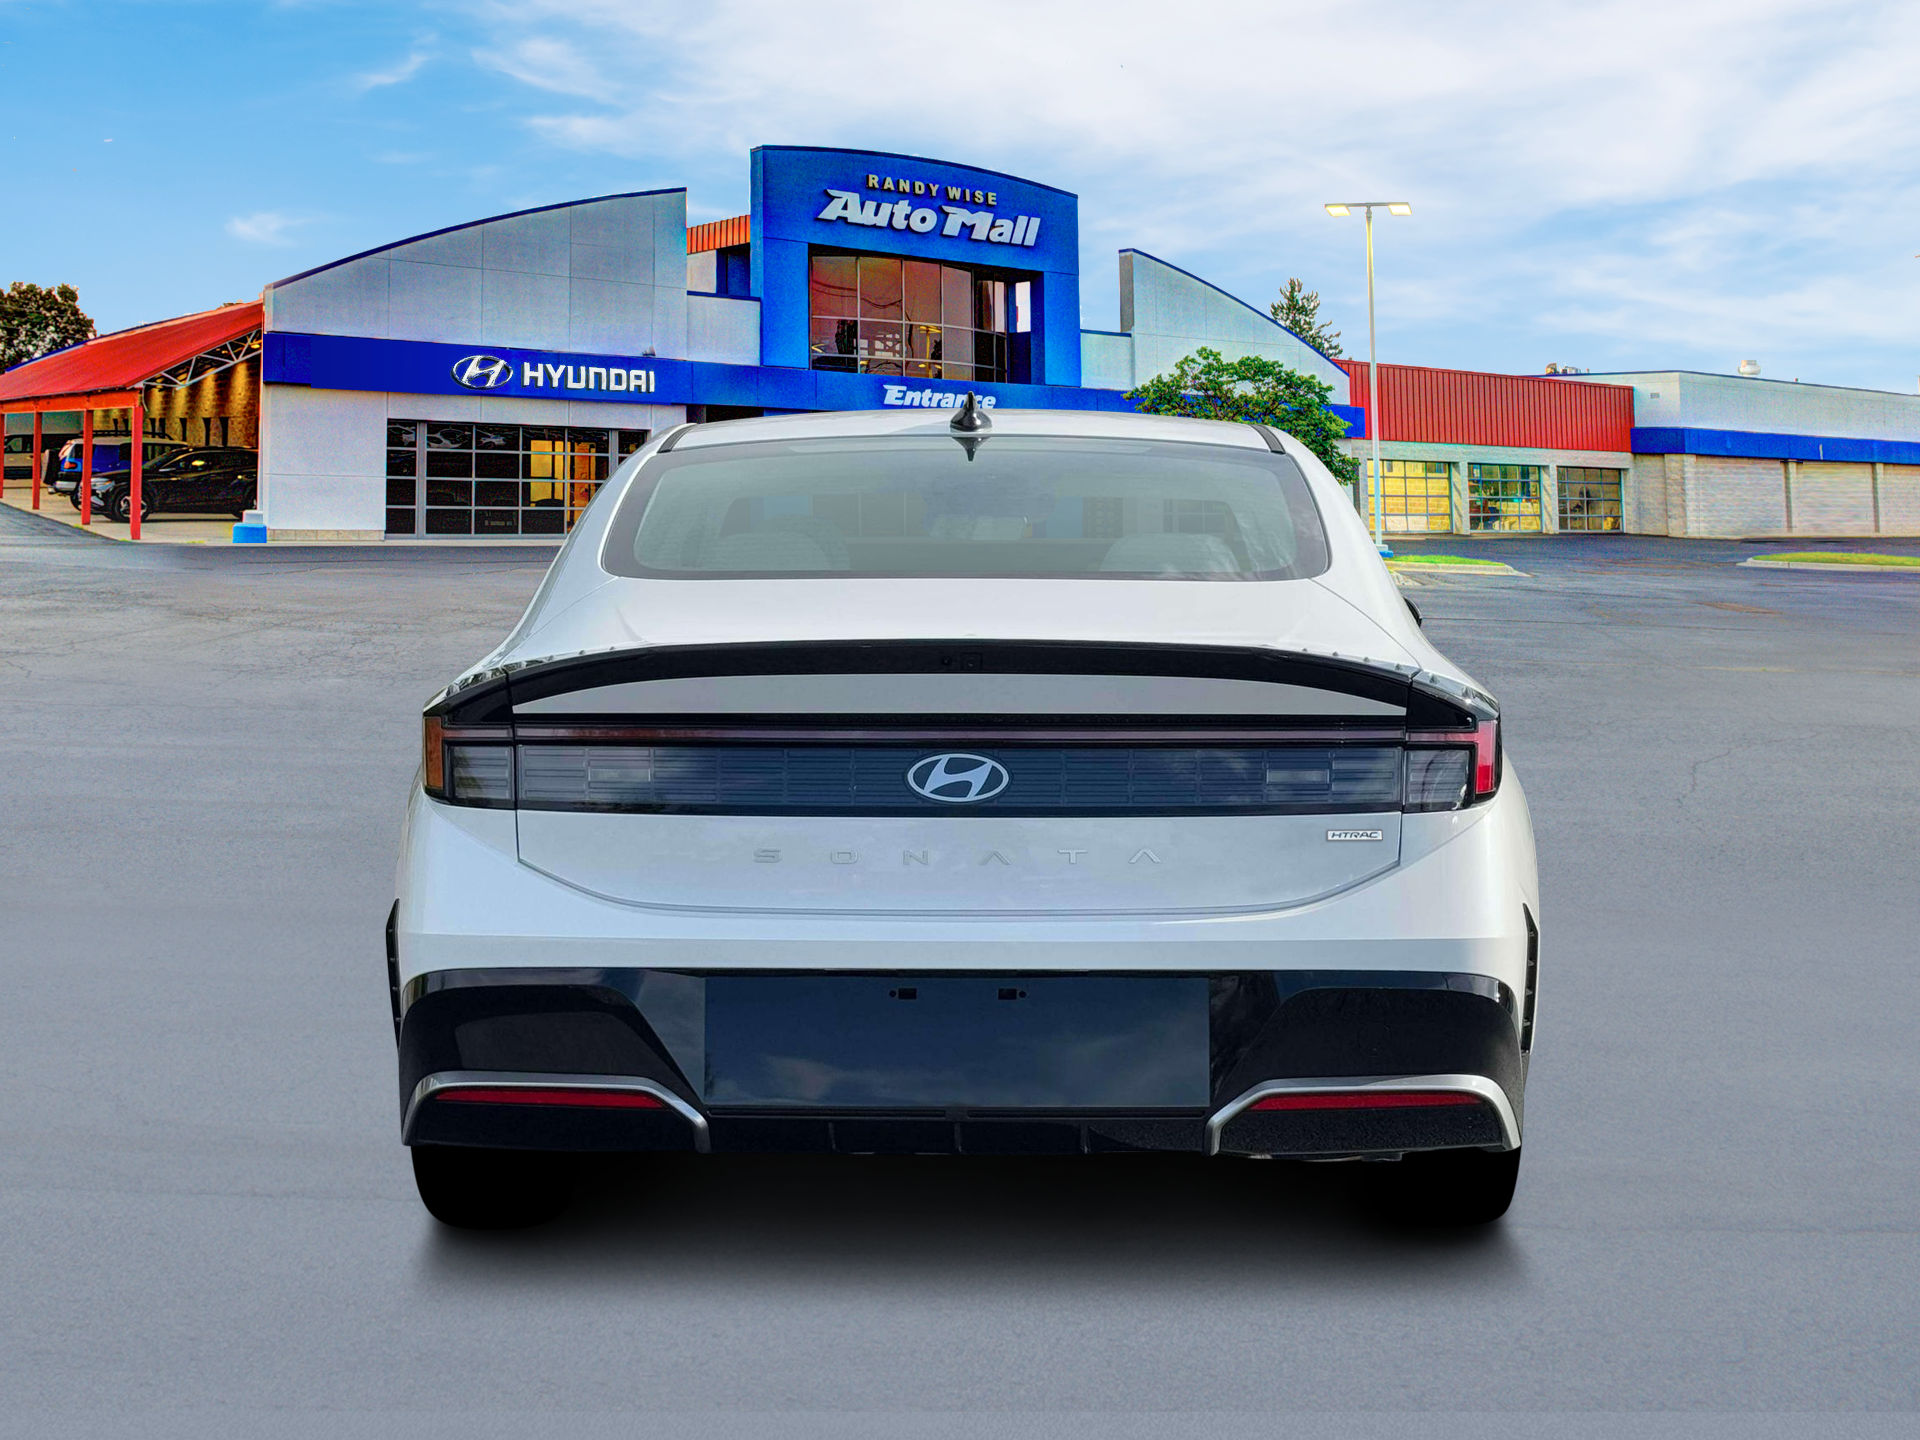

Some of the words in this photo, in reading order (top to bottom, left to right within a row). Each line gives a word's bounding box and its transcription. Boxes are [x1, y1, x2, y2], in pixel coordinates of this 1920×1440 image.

[866, 173, 940, 197] RANDY
[946, 186, 998, 206] WISE
[817, 188, 939, 234] Auto
[940, 205, 1041, 247] Mall
[522, 361, 656, 393] HYUNDAI
[1330, 831, 1380, 840] HTRAC
[753, 848, 1162, 865] SONATA
